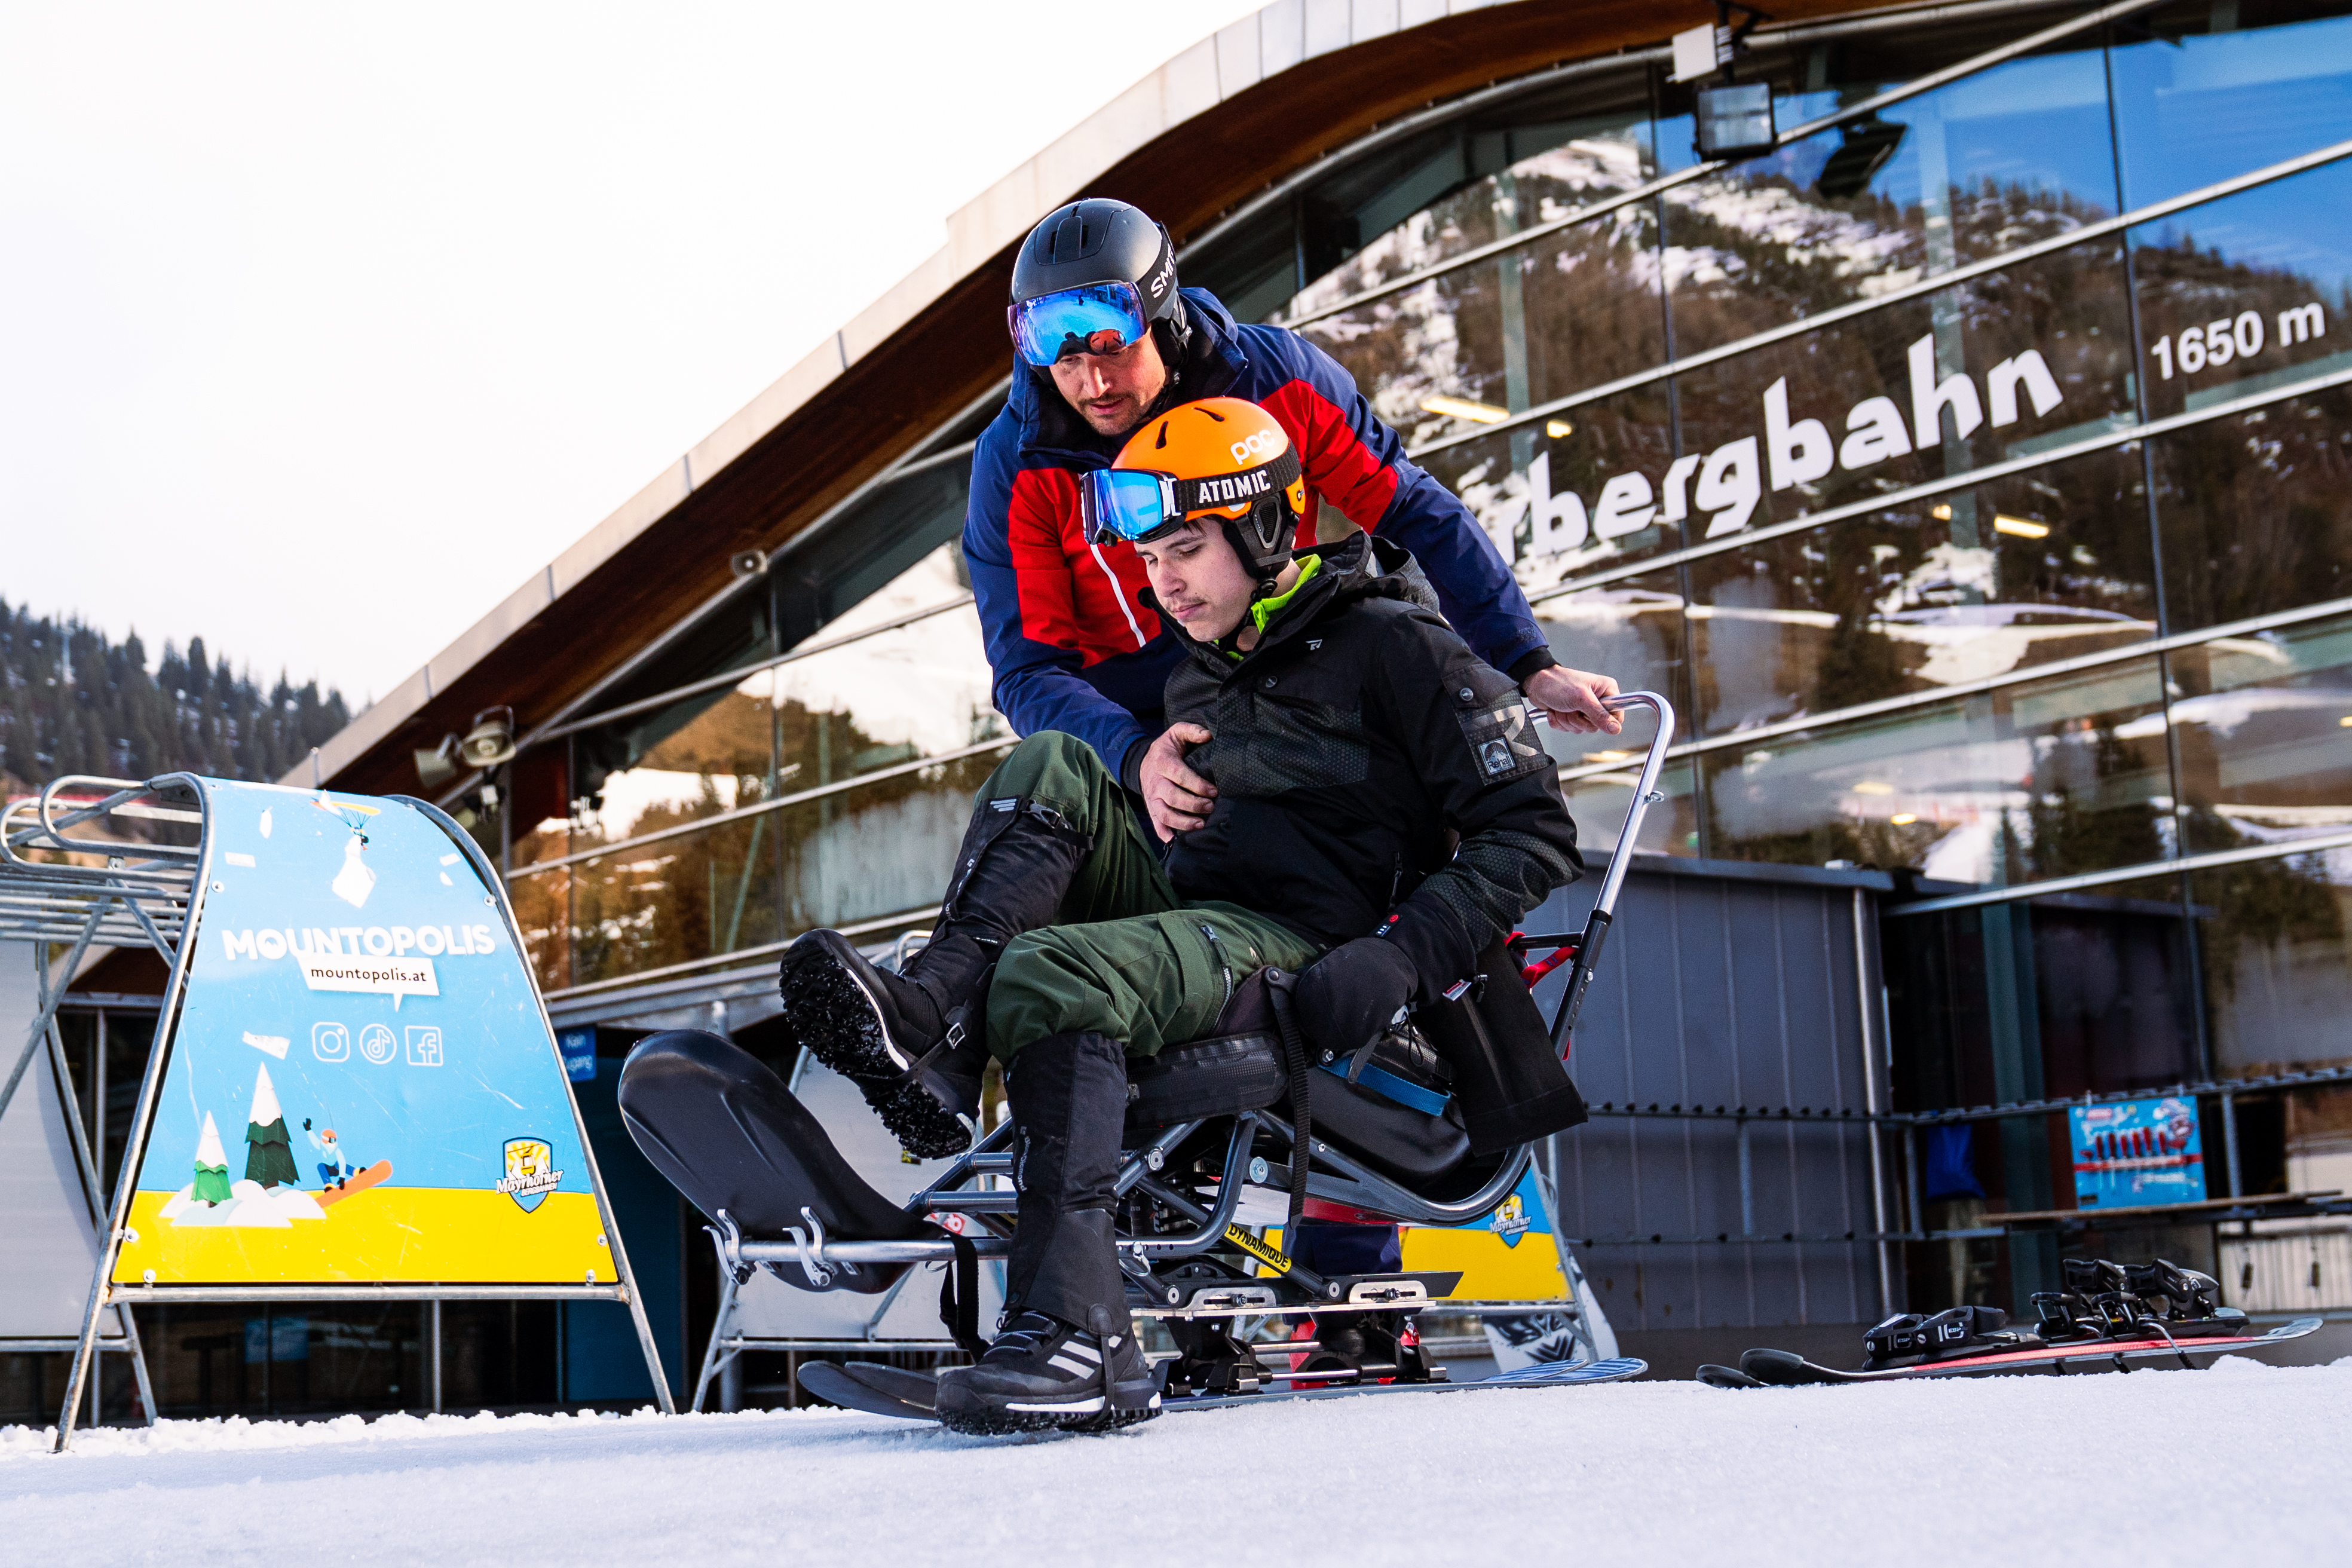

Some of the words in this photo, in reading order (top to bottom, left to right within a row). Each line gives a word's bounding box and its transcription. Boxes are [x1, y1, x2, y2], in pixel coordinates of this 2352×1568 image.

[1151, 243, 1175, 298] SMIT
[2151, 310, 2264, 381] 1650
[2278, 302, 2326, 347] m
[1492, 332, 2063, 566] rbergbahn
[1199, 470, 1271, 504] ATOMIC
[221, 924, 496, 960] MOUNTOPOLIS
[311, 967, 427, 984] mountopolis.at
[496, 1169, 564, 1195] Mayrhofner
[1228, 1225, 1290, 1268] DYNAMIQUE
